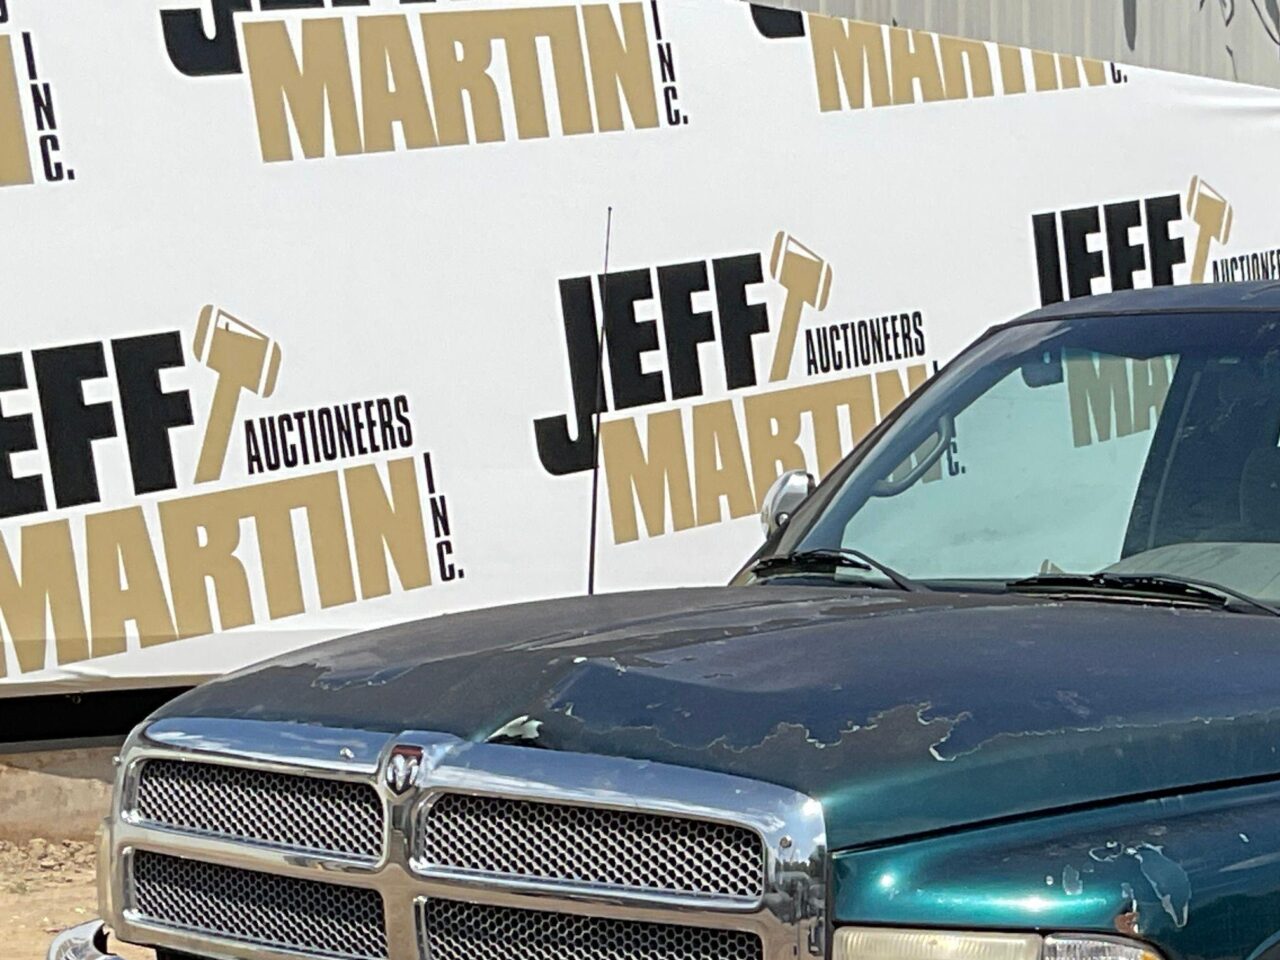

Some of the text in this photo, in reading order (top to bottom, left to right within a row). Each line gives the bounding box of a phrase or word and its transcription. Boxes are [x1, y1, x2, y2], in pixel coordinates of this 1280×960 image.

[242, 1, 660, 163] MARTIN
[533, 252, 770, 477] JEFF
[804, 311, 926, 376] AUCTIONEERS
[244, 394, 414, 476] AUCTIONEERS
[0, 455, 433, 678] MARTIN
